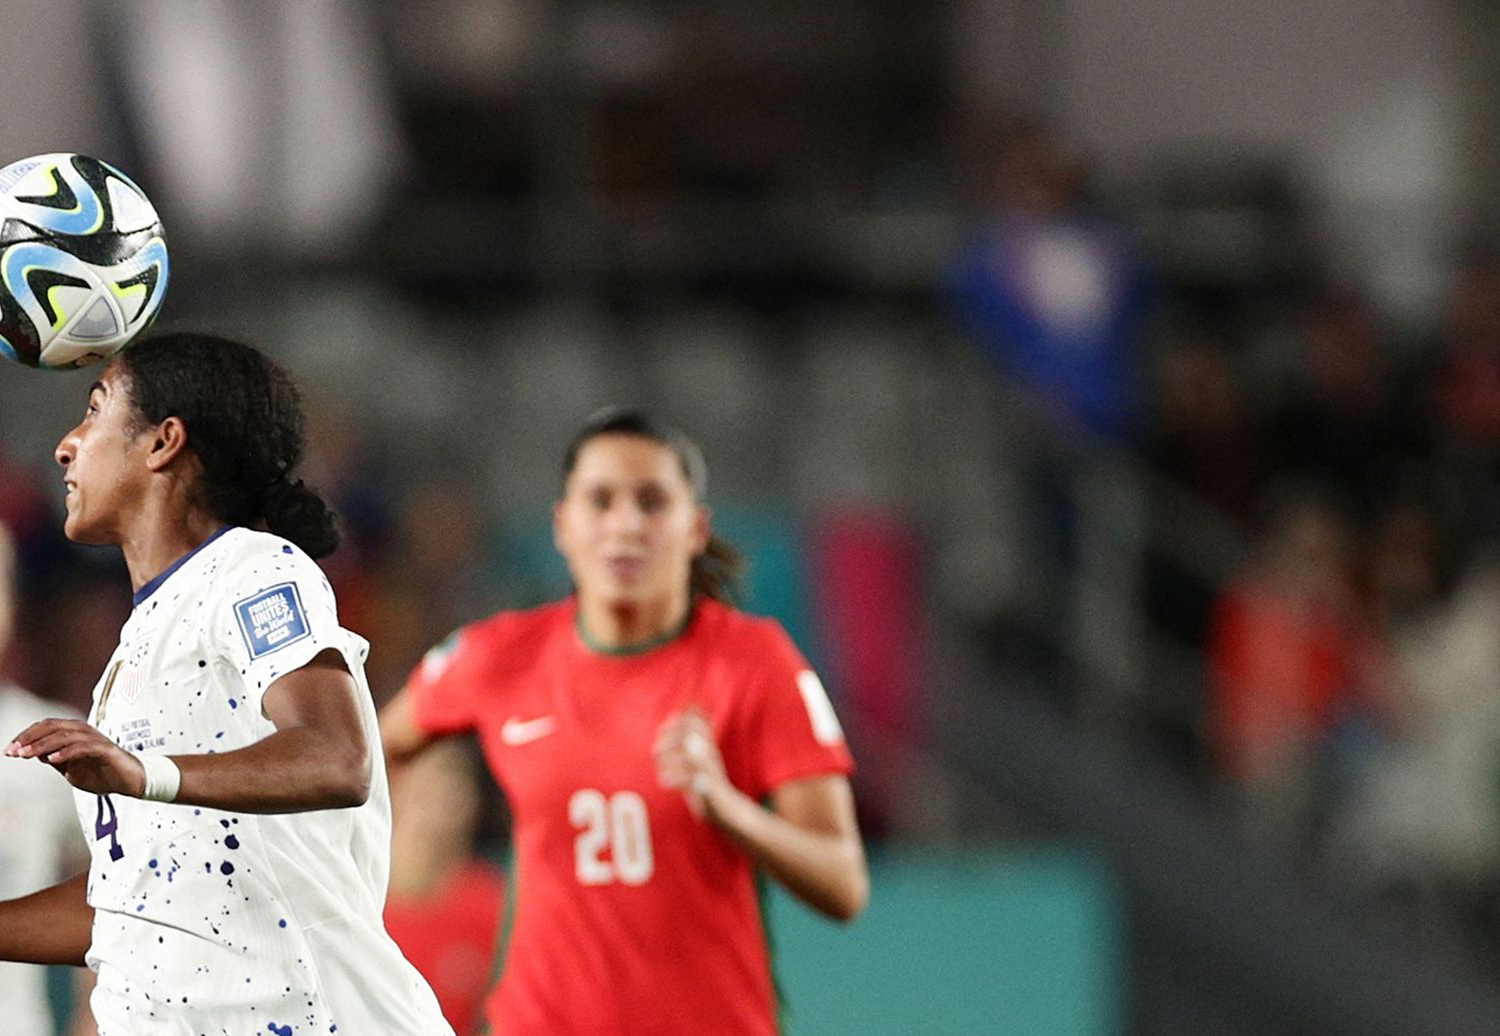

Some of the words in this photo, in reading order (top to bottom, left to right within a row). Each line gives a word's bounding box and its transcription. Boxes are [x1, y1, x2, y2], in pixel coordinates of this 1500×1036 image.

[251, 602, 290, 628] UNITES
[95, 794, 125, 862] 4
[568, 788, 655, 886] 20
